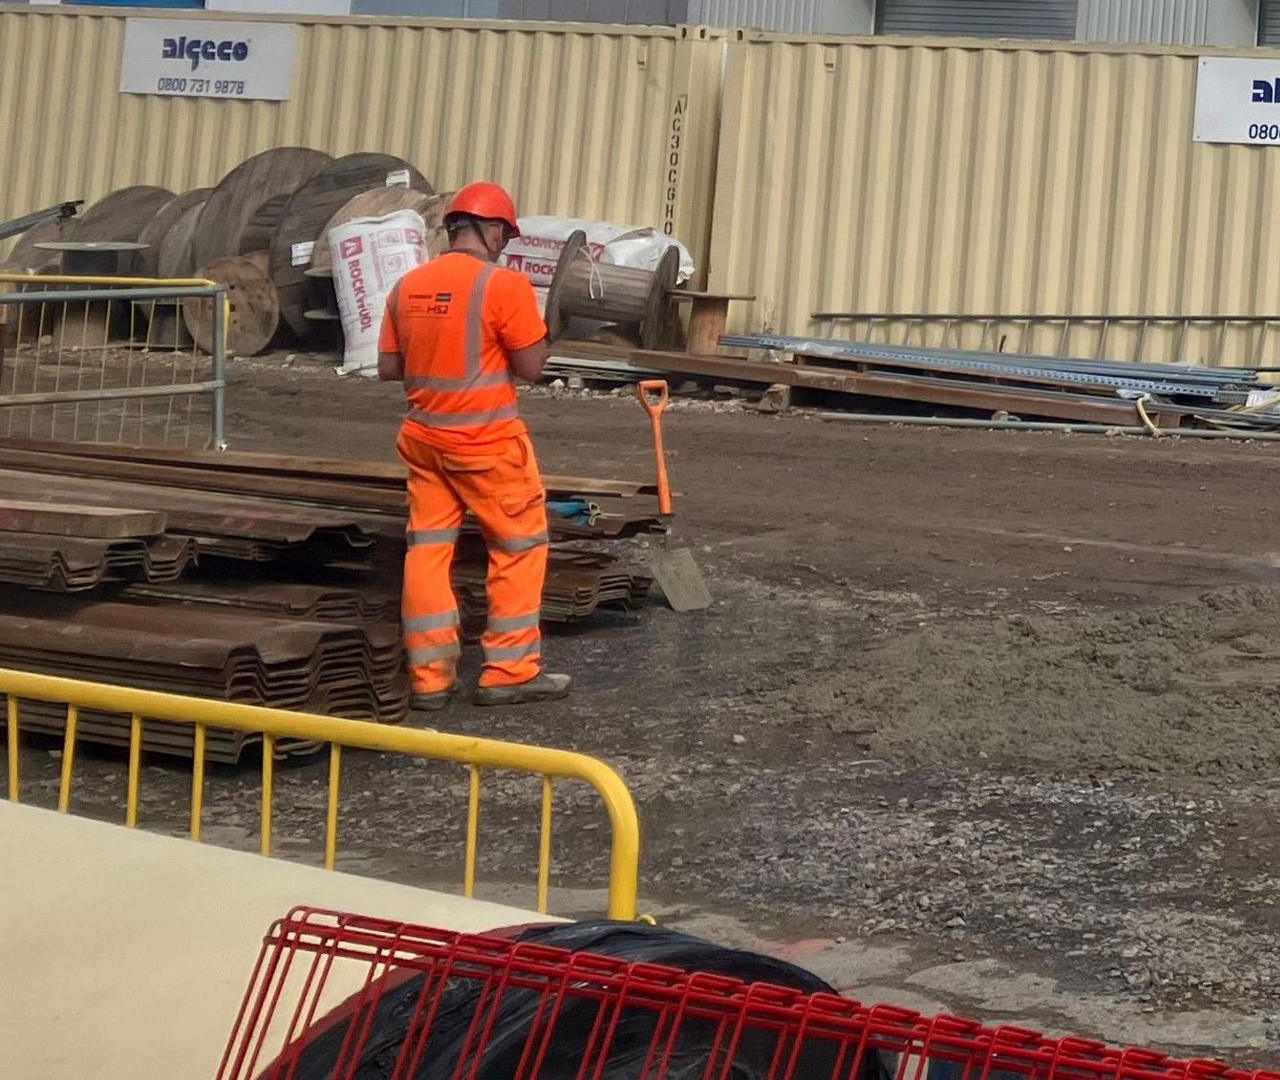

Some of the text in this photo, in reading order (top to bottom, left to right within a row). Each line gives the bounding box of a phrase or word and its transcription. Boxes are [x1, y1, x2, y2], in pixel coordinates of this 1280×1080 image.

[161, 36, 249, 72] algeco
[157, 77, 245, 95] 0800 731 9878
[427, 304, 449, 314] HS2
